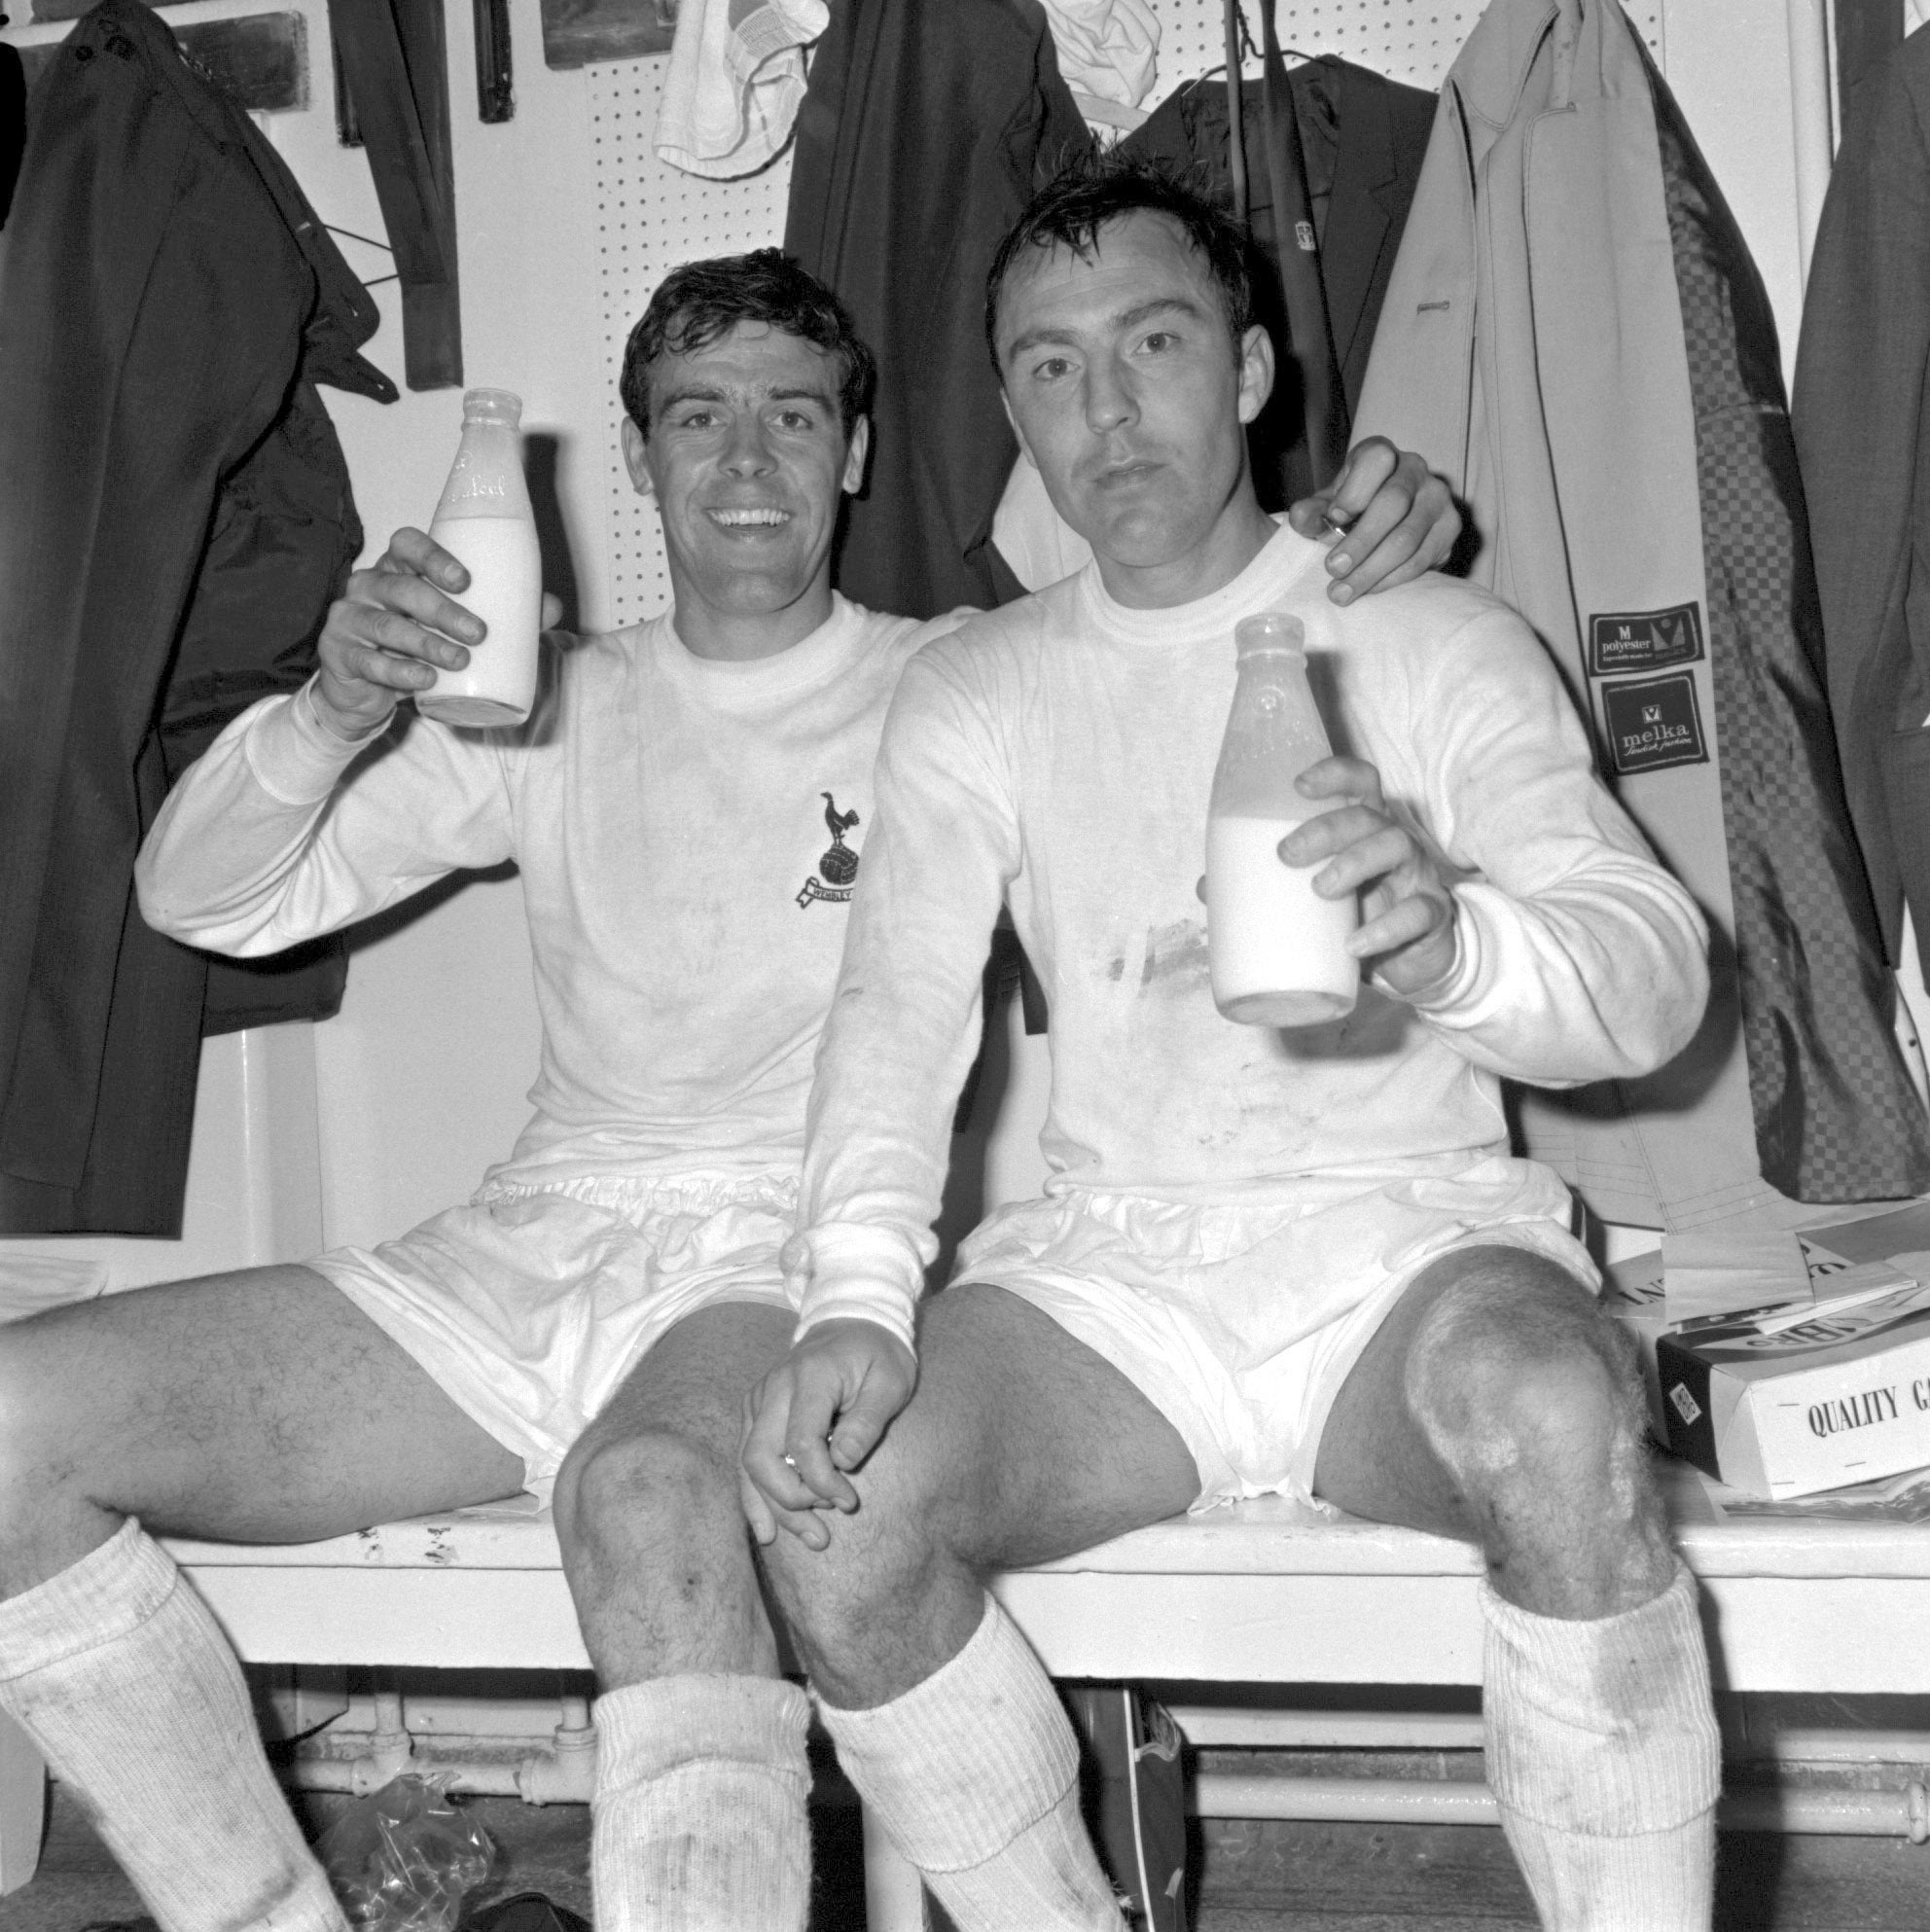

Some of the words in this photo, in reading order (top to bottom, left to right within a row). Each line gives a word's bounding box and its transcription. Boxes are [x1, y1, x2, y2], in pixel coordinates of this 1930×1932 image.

[1603, 640, 1652, 653] polyester
[1623, 724, 1690, 747] melka
[1808, 1385, 1899, 1438] QUALITY
